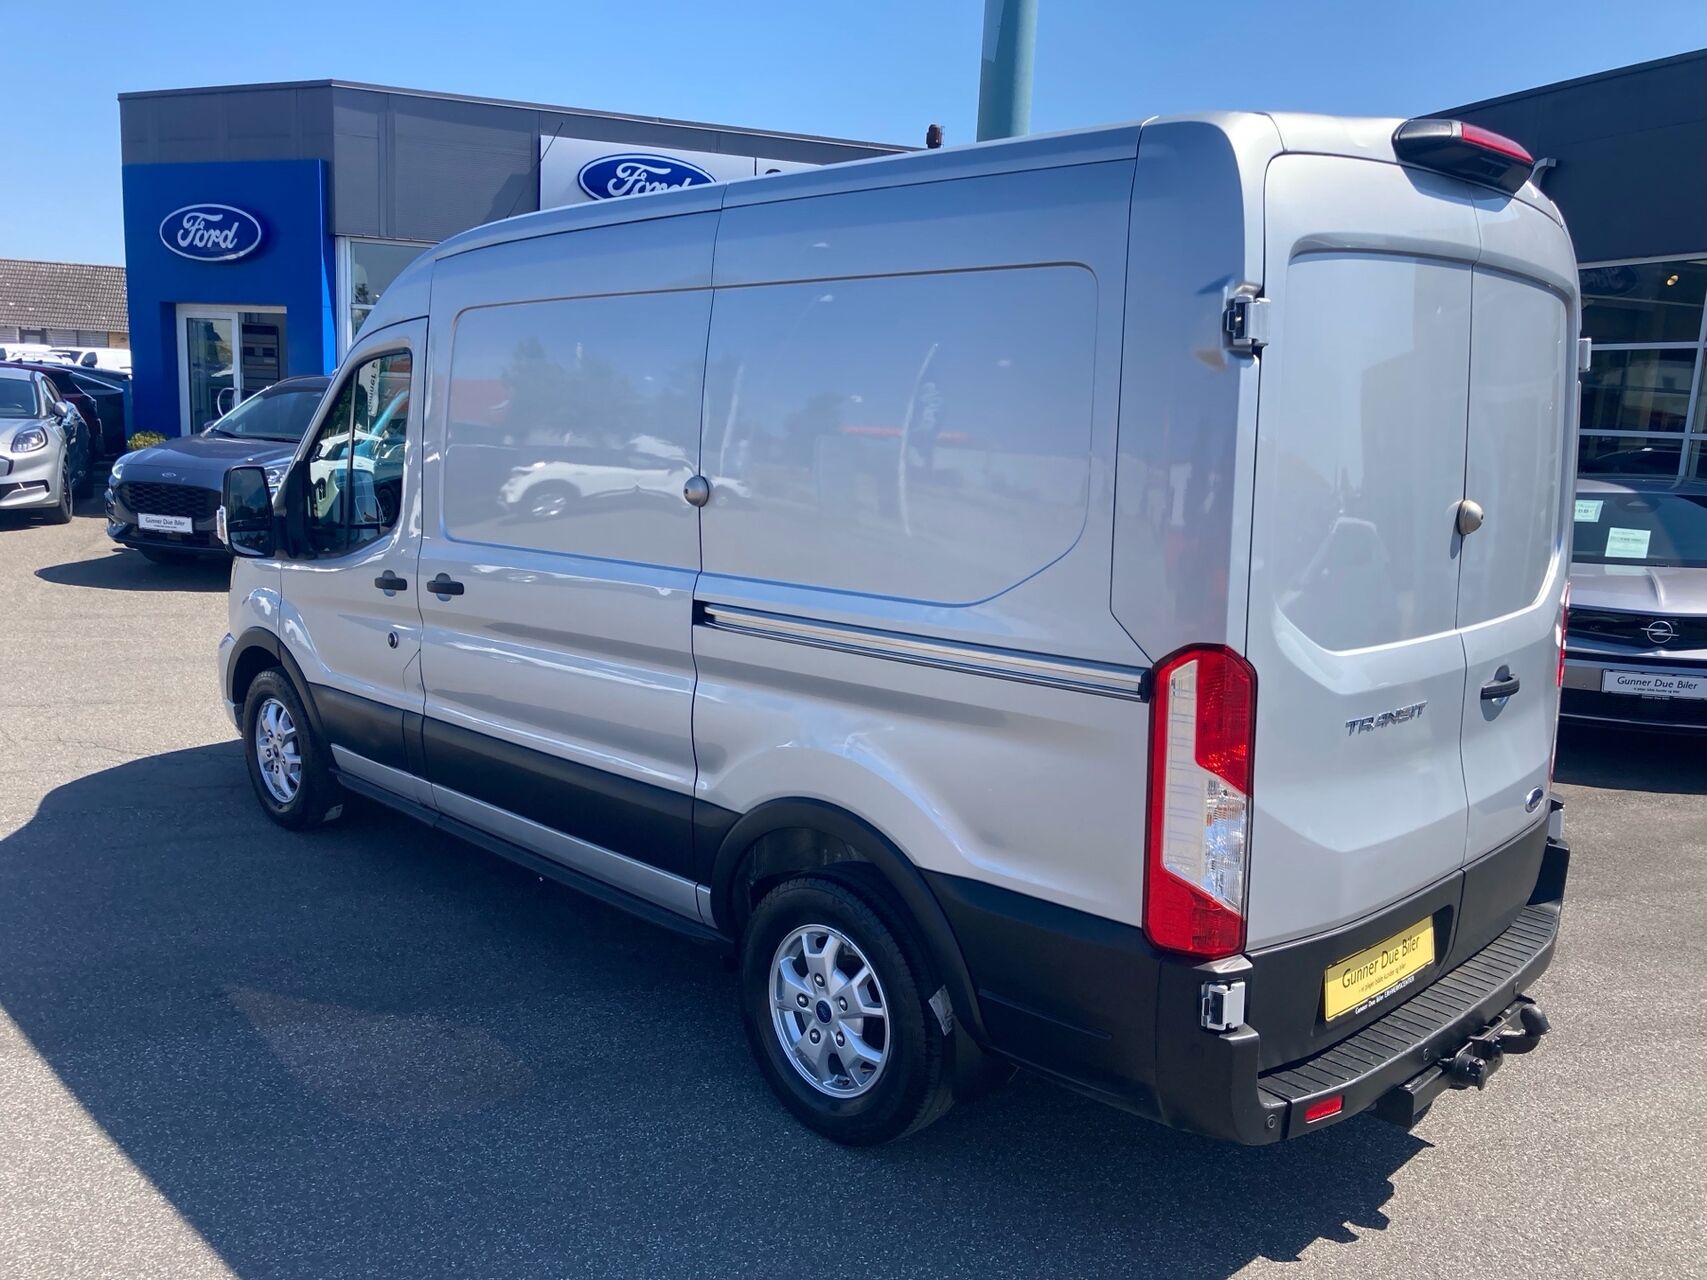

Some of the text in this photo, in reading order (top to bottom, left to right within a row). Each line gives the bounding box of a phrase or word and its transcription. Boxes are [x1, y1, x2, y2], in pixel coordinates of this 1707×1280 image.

[177, 212, 239, 249] Ford
[1617, 676, 1651, 687] Gunner
[1654, 679, 1674, 688] Due
[1677, 680, 1698, 690] Biler
[1345, 700, 1428, 737] TRANSIT
[1342, 959, 1379, 988] Gunner
[1381, 950, 1399, 969] Due
[1402, 935, 1420, 957] Biler
